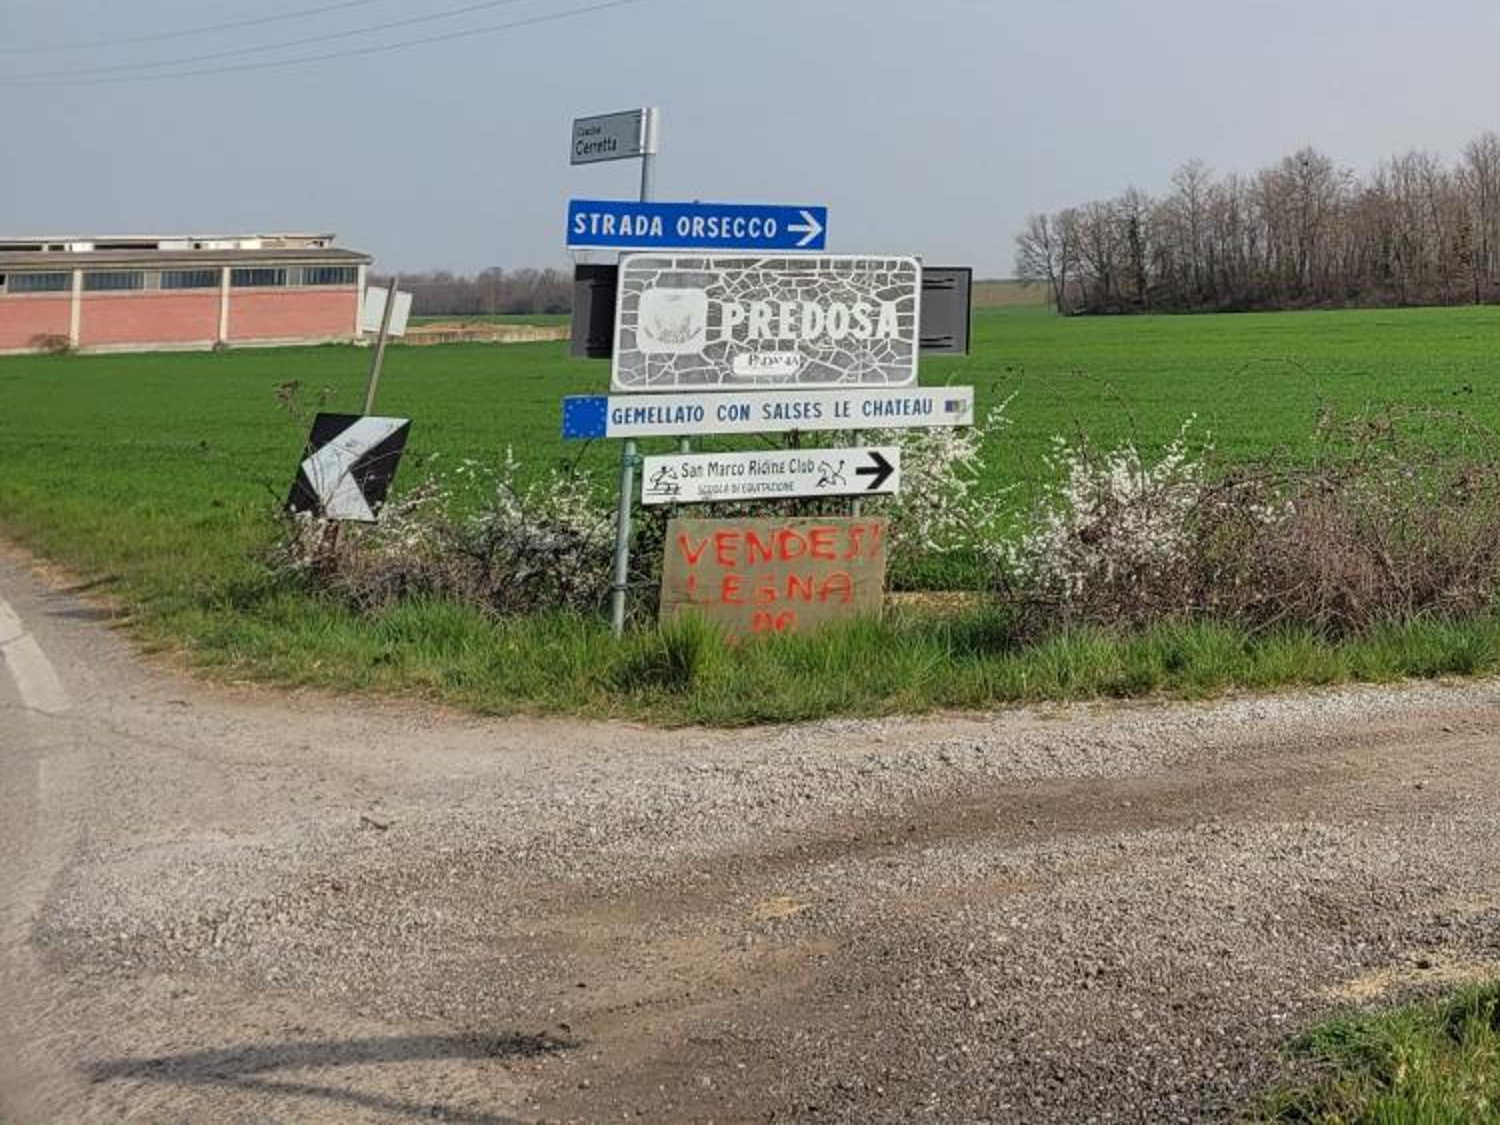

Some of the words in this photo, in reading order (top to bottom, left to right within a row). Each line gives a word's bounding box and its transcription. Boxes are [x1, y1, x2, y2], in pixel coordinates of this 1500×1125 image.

[573, 213, 663, 237] STRADA
[676, 216, 777, 238] ORSECCO
[720, 301, 899, 341] PREDOSA
[611, 405, 705, 425] GEMELLATO
[717, 403, 750, 422] CON
[762, 402, 823, 420] SALSES
[834, 401, 850, 418] LE
[862, 398, 933, 417] CHATEAU
[681, 462, 703, 478] San
[707, 460, 745, 476] Marco
[749, 458, 785, 476] Riding
[788, 458, 815, 474] Club
[684, 572, 854, 606] LEGNA
